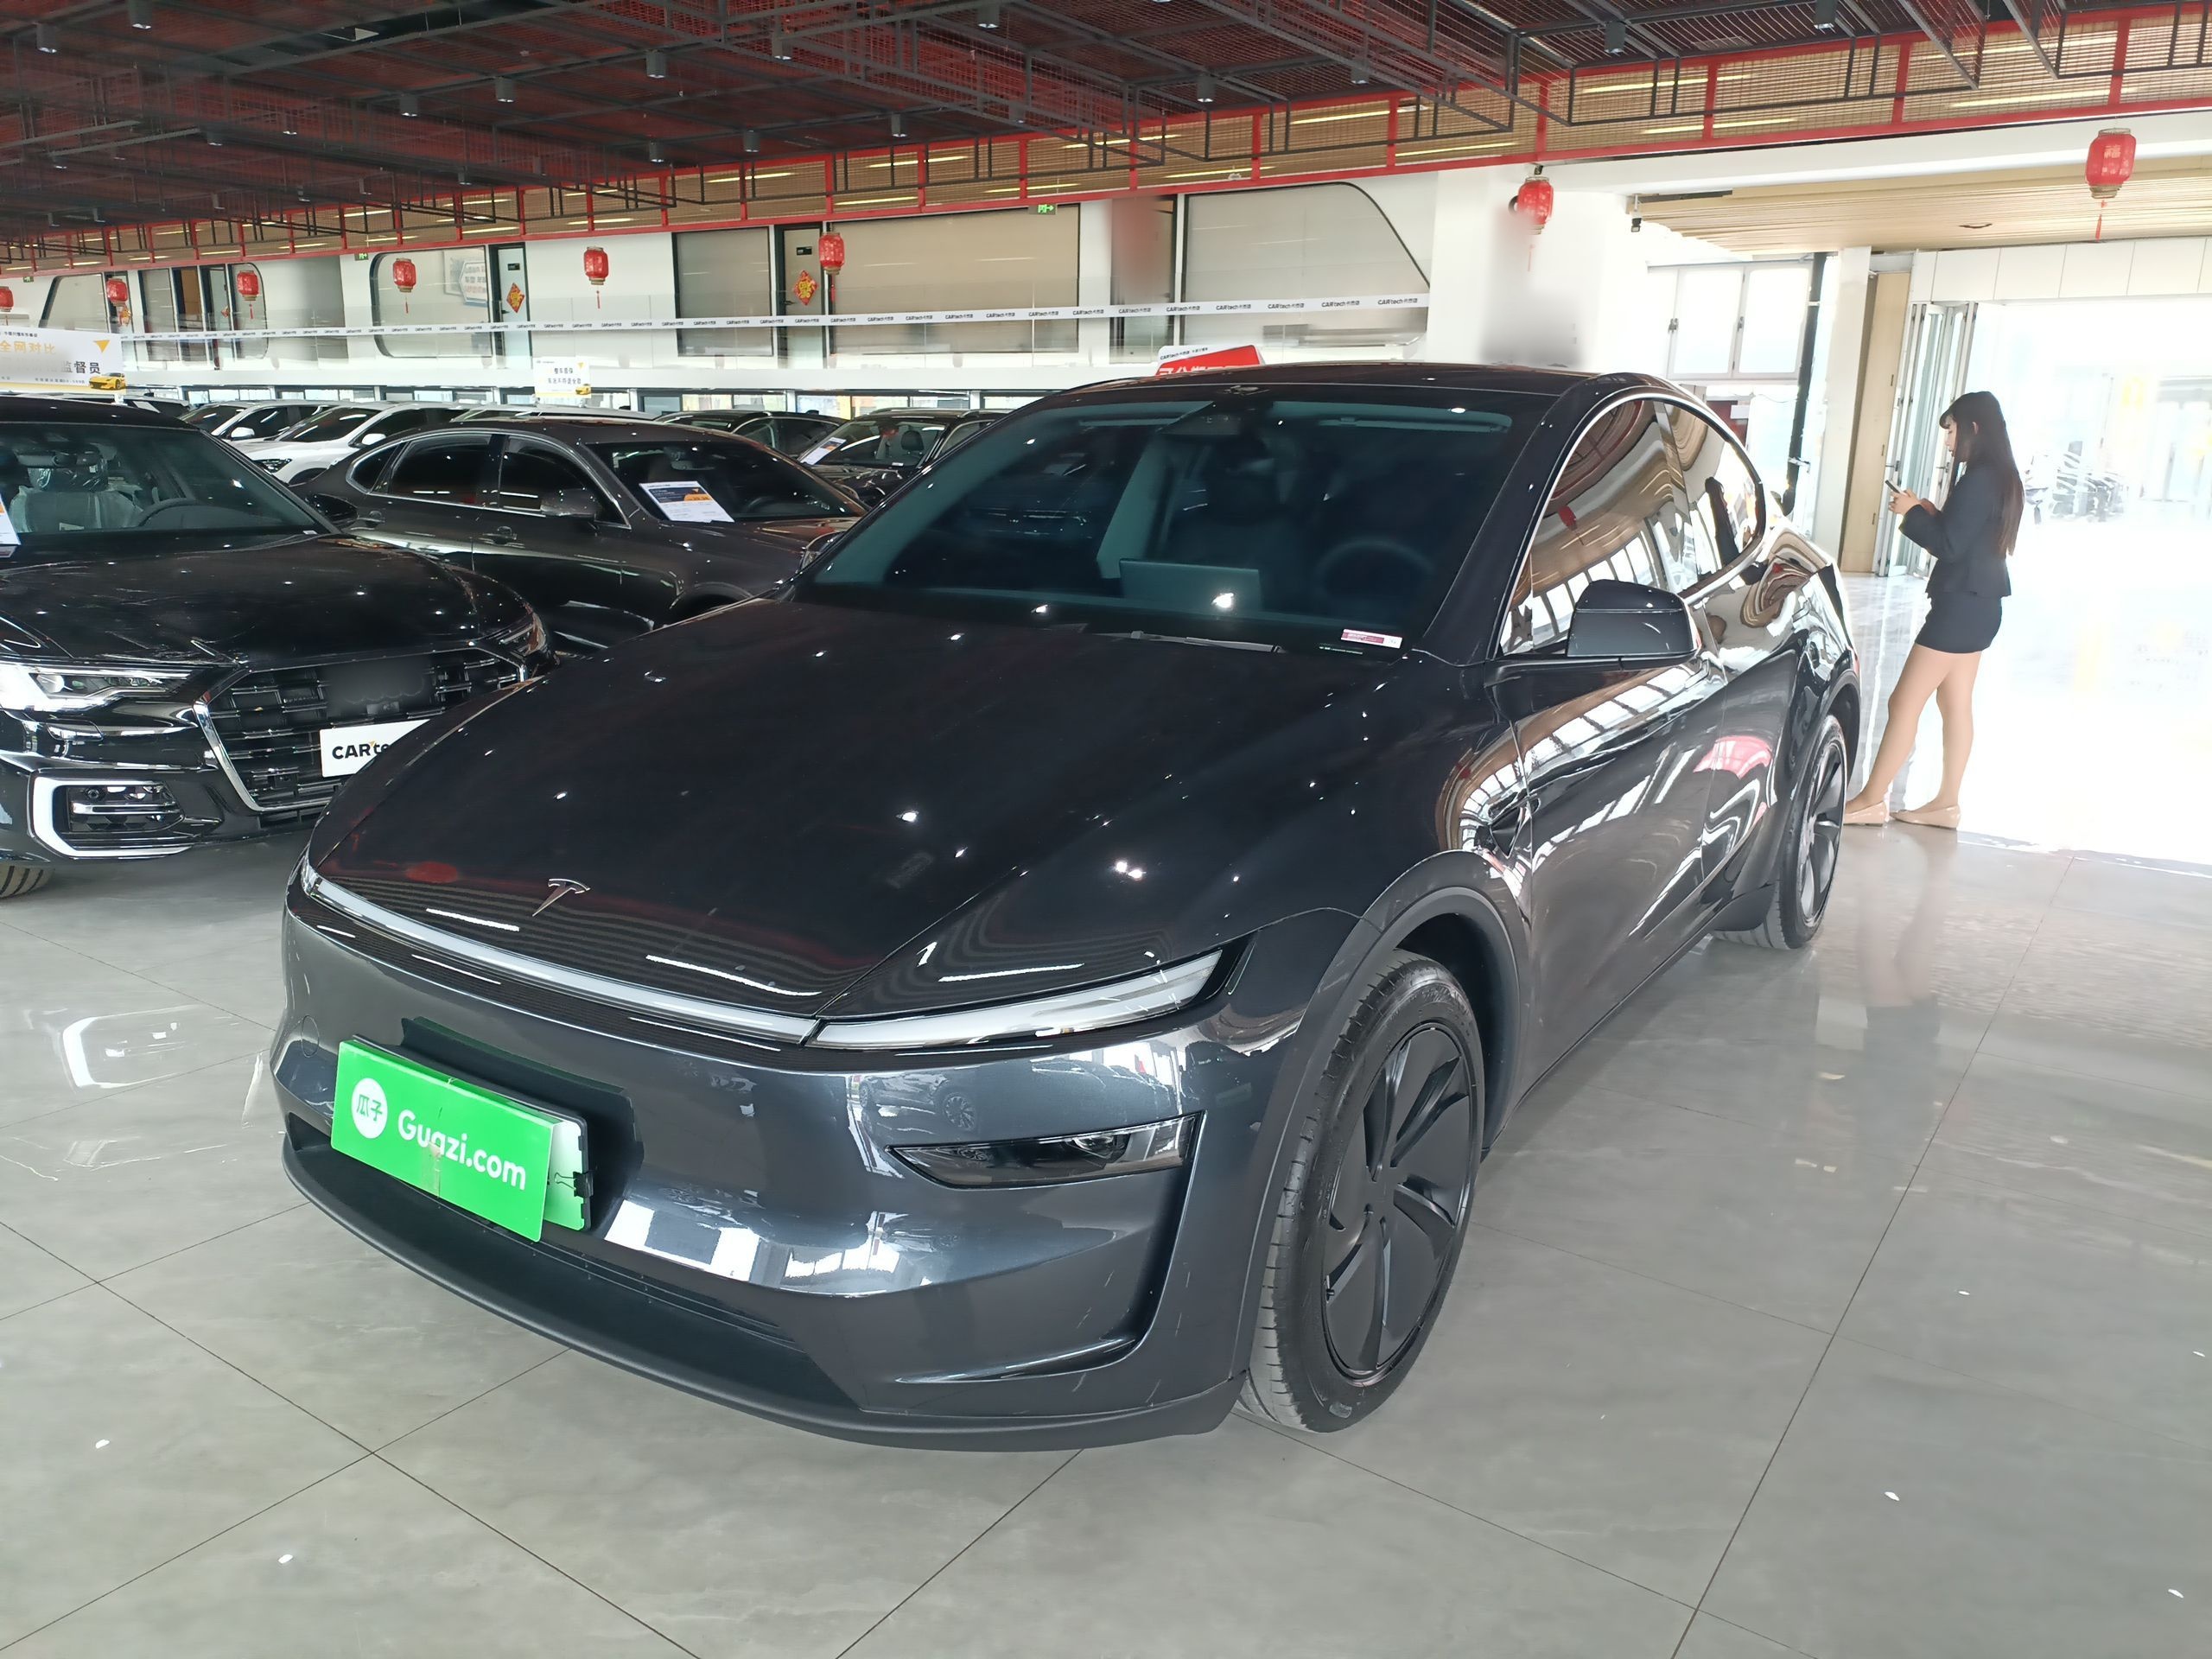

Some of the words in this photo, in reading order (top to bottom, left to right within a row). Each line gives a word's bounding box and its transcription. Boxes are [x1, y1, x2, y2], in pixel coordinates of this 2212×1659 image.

[332, 743, 391, 760] CARte
[356, 1093, 383, 1122] 瓜子
[397, 1109, 526, 1192] Guazi.com
